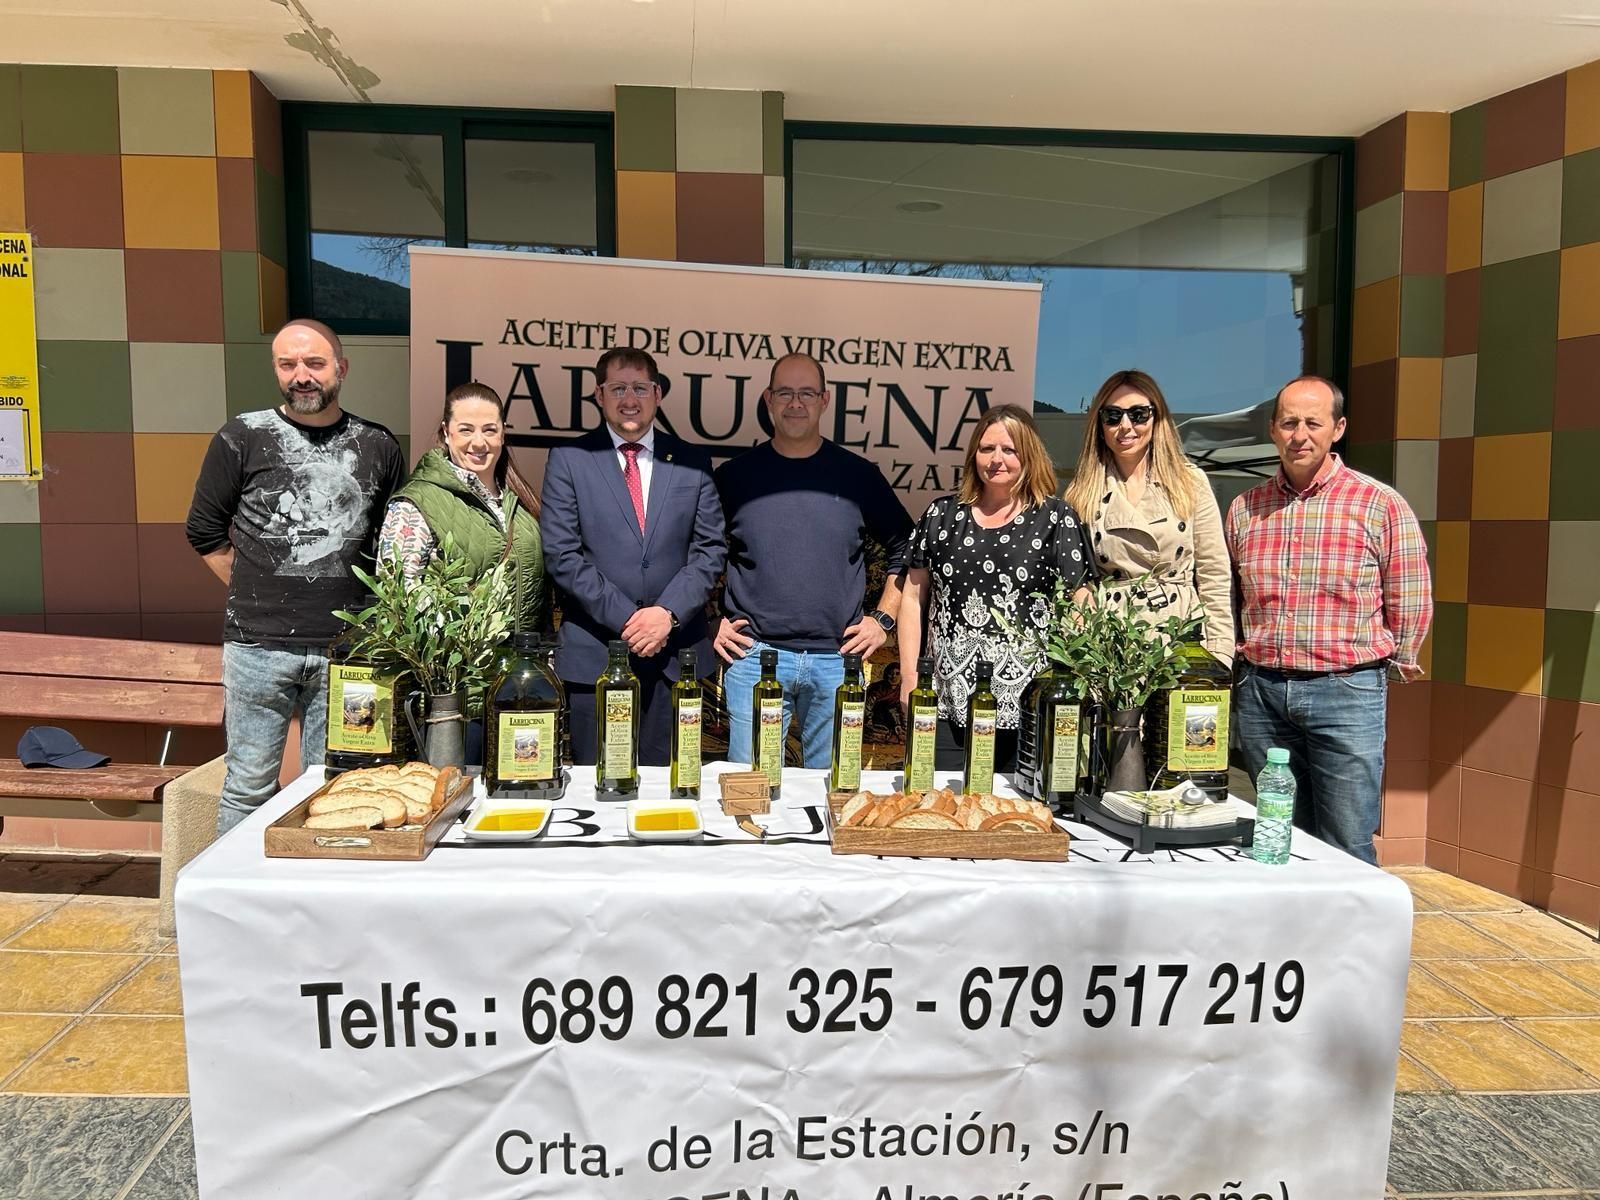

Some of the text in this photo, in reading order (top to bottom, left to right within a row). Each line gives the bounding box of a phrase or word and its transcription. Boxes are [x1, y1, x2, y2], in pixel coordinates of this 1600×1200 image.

[0, 264, 27, 277] NAL
[499, 319, 1015, 372] ACEITE DE OLIVA VIRGEN EXTRA
[1182, 694, 1222, 704] LABRUCENA
[509, 717, 545, 726] LABRUCENA
[300, 959, 1305, 1049] Telfs.: 689 821 325 - 679 517 219
[495, 1110, 1131, 1178] Crta. de la Estación, s/n
